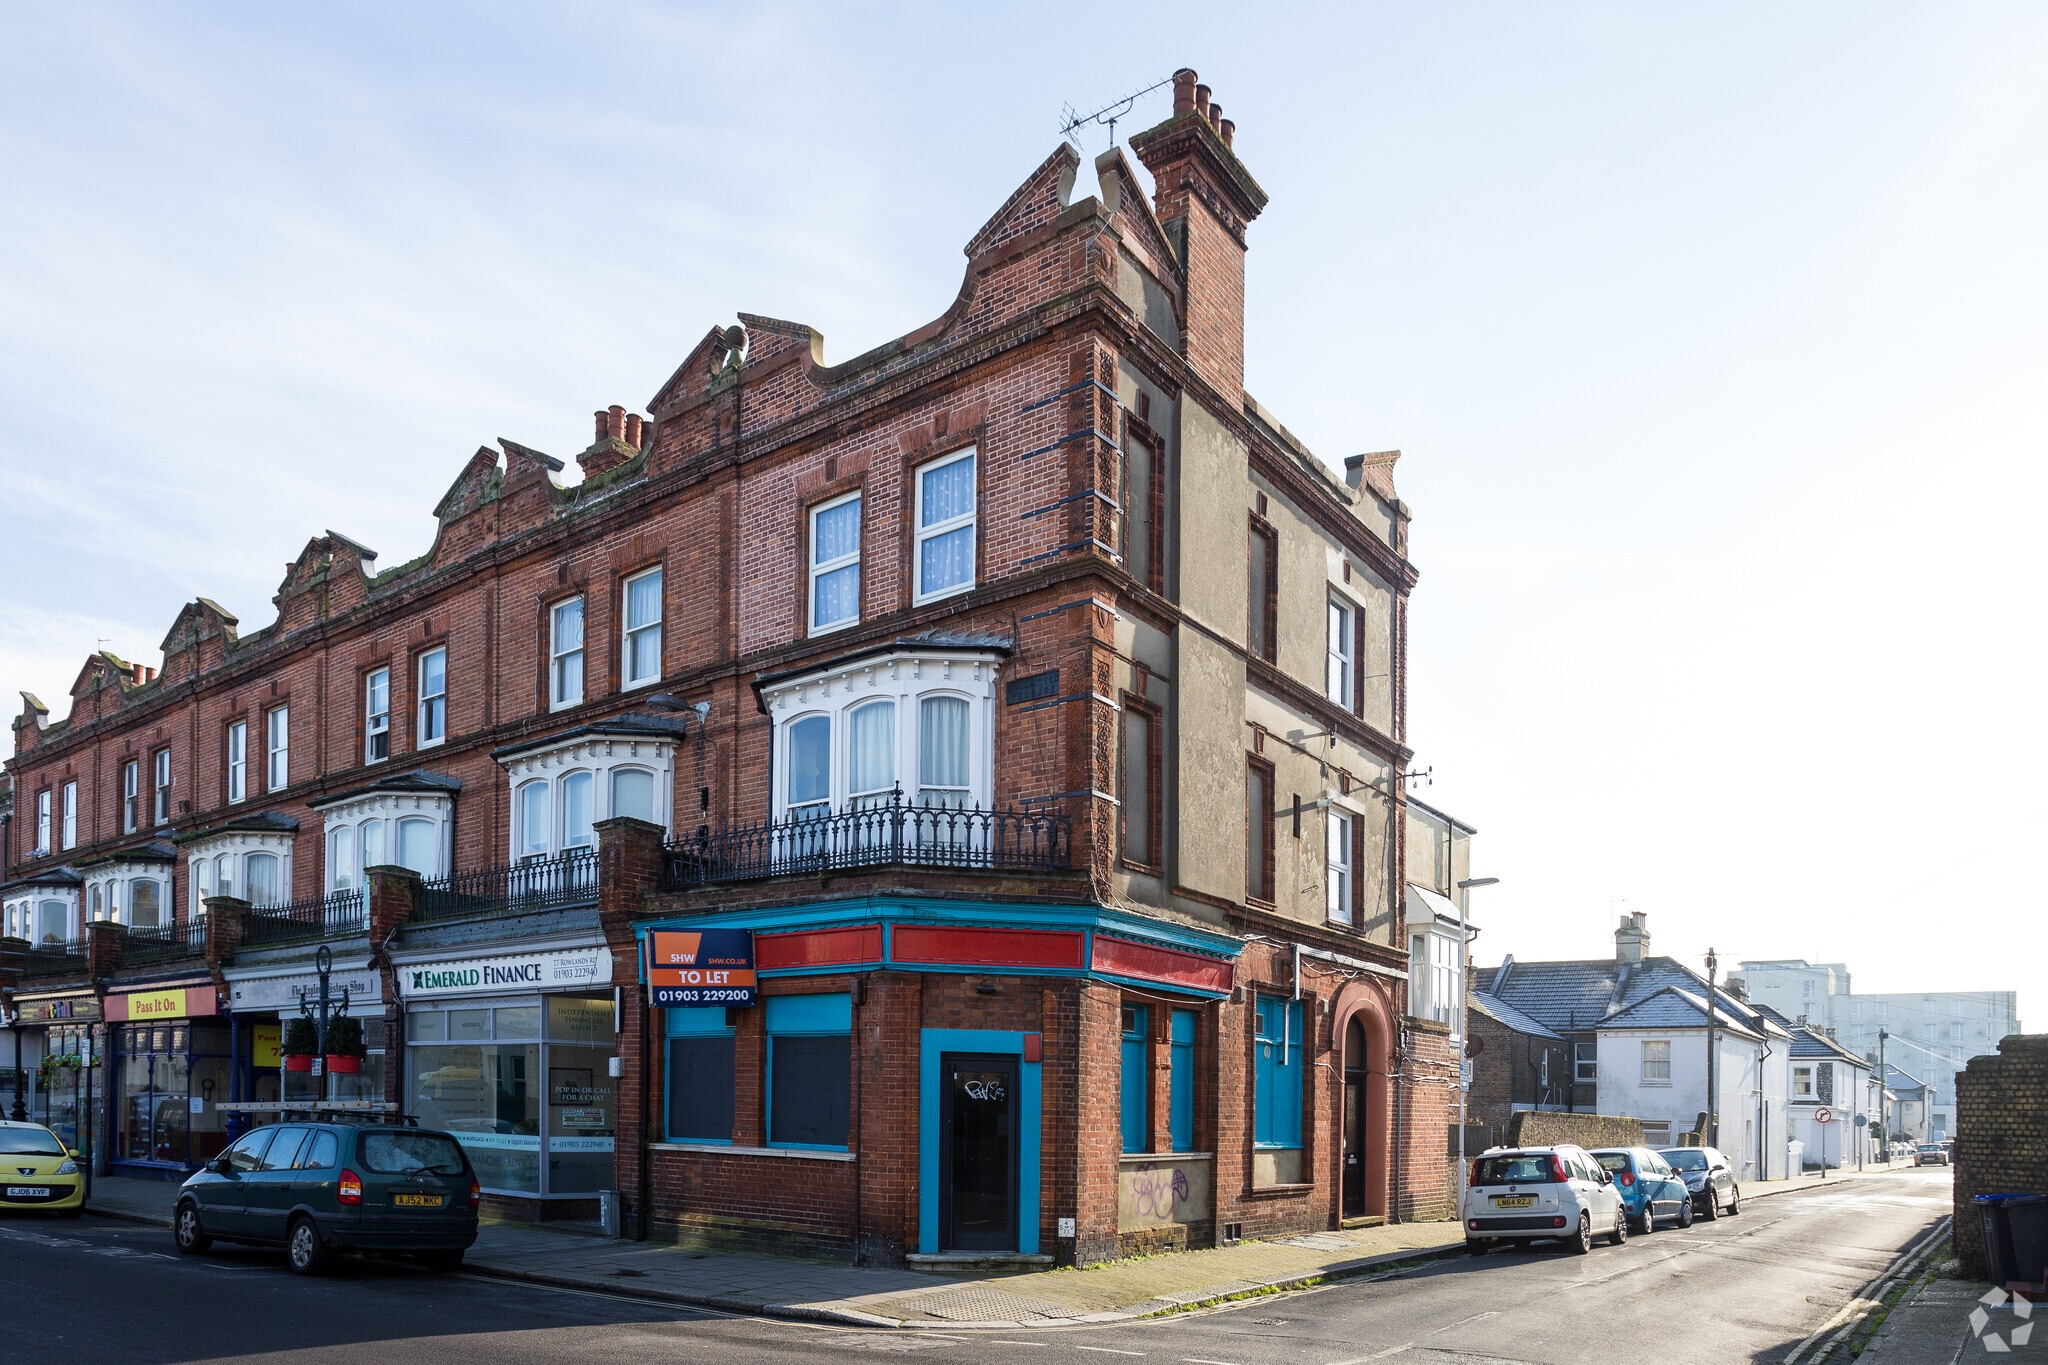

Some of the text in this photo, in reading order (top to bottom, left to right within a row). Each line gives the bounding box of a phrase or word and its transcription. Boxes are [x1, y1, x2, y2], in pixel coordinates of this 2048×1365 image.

[560, 958, 588, 966] ROWLANDS
[670, 954, 695, 963] SHW
[425, 963, 542, 989] EMERALD FINANCE
[553, 966, 598, 979] 01903 222940
[678, 971, 729, 984] TO LET
[659, 989, 749, 1001] 01903 229200
[136, 998, 176, 1013] Pass It On
[558, 1008, 611, 1017] INDEPENDENT
[565, 1016, 604, 1024] FINANCIAL
[399, 1195, 422, 1205] AJ52
